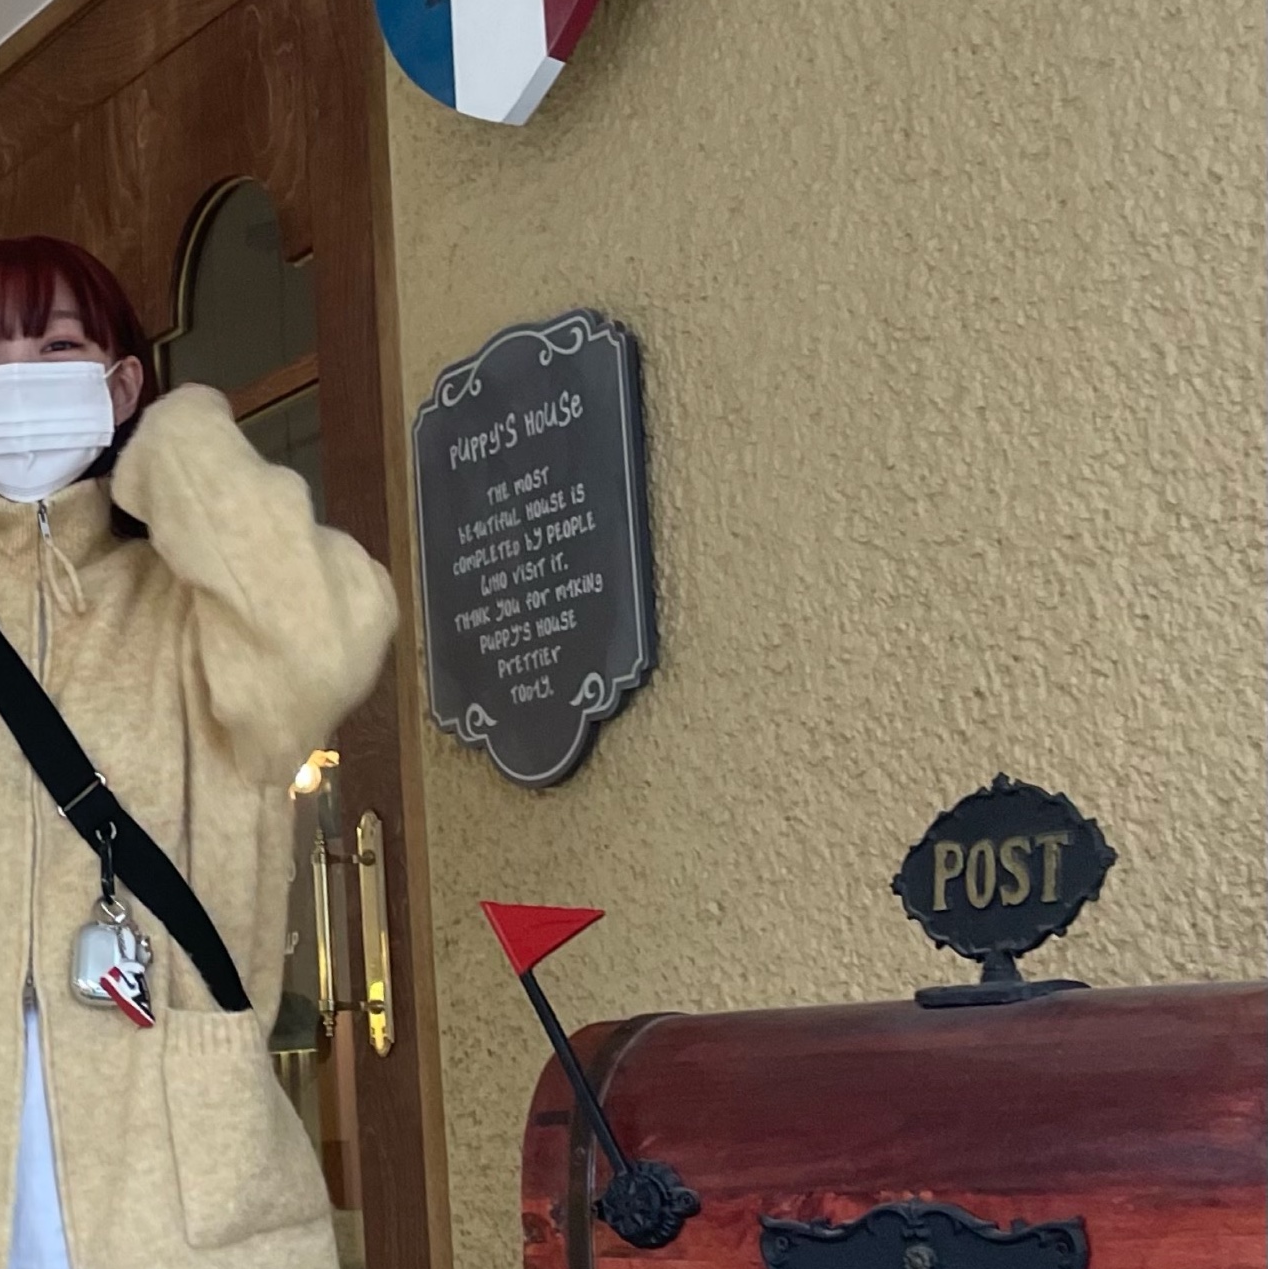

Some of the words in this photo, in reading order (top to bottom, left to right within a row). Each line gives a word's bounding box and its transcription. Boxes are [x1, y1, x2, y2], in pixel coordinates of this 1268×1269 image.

[486, 481, 510, 505] THE
[525, 490, 567, 521] HOUSE
[547, 511, 596, 545] PEOPLE
[481, 571, 508, 596] WHO
[454, 606, 491, 632] THANK
[496, 597, 520, 622] YOU
[535, 609, 577, 638] HOUSE
[932, 831, 1070, 912] POST
